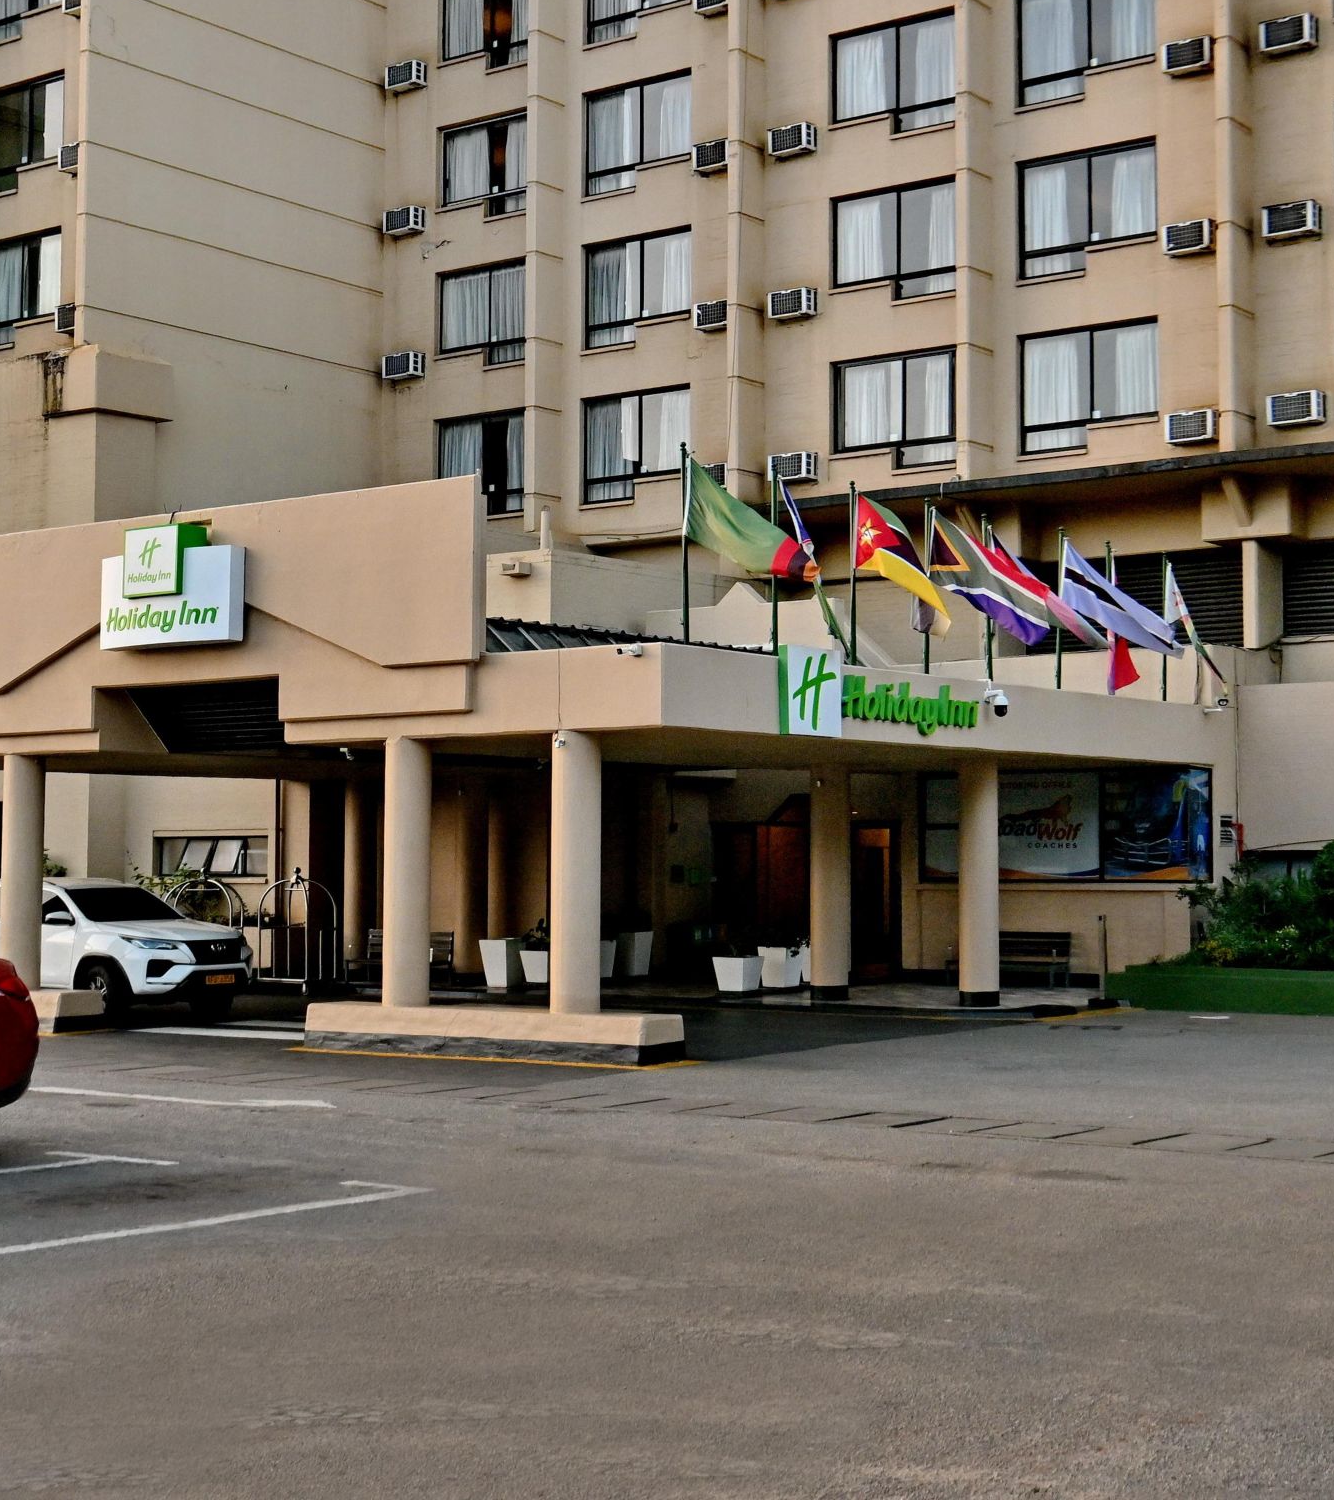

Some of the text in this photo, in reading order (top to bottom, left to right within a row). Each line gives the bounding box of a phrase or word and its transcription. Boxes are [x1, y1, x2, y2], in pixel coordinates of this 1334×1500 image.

[139, 537, 162, 568] H
[127, 569, 172, 584] Holiday Inn
[106, 600, 218, 633] Holiday Inn
[792, 653, 837, 731] H
[842, 674, 980, 737] Holiday Inn
[998, 817, 1083, 841] oadWolf
